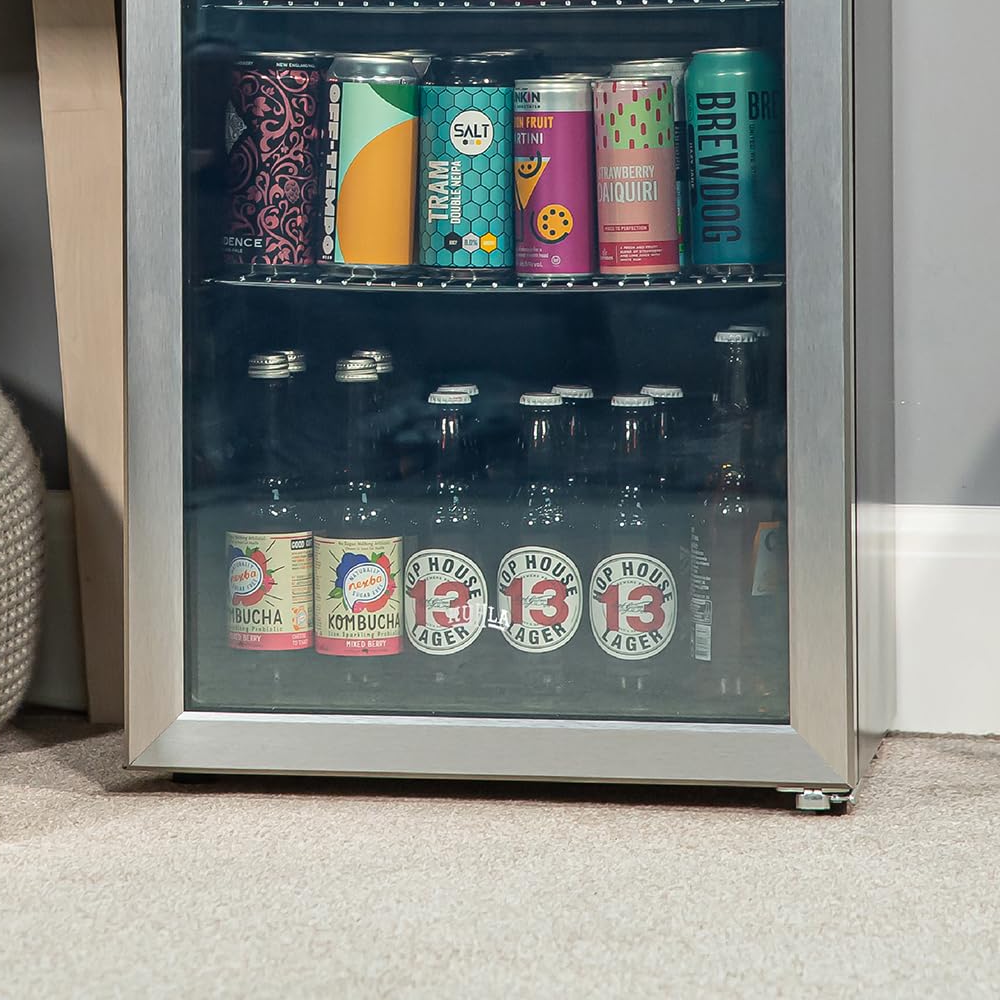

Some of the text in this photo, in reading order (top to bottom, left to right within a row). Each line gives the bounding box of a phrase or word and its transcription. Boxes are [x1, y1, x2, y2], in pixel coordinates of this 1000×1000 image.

[515, 91, 541, 103] NKIN
[453, 123, 490, 138] SALT
[526, 116, 554, 128] FRUIT
[696, 92, 742, 243] BREWDOG
[428, 160, 449, 224] TRAM
[450, 160, 462, 224] DOUBLE NEIPA
[348, 576, 382, 591] nexba
[349, 567, 380, 581] NATURALLY
[406, 557, 481, 599] HOP HOUSE
[499, 554, 578, 597] HOP HOUSE
[593, 567, 613, 601] HOP
[622, 561, 674, 603] HOUSE
[407, 579, 472, 628] 13
[504, 577, 569, 626] 13
[601, 584, 665, 632] 13
[328, 613, 400, 630] KOMBUCHA
[367, 640, 387, 648] BERRY
[411, 625, 470, 646] LAGER
[506, 623, 567, 645] LAGER
[602, 629, 663, 651] LAGER
